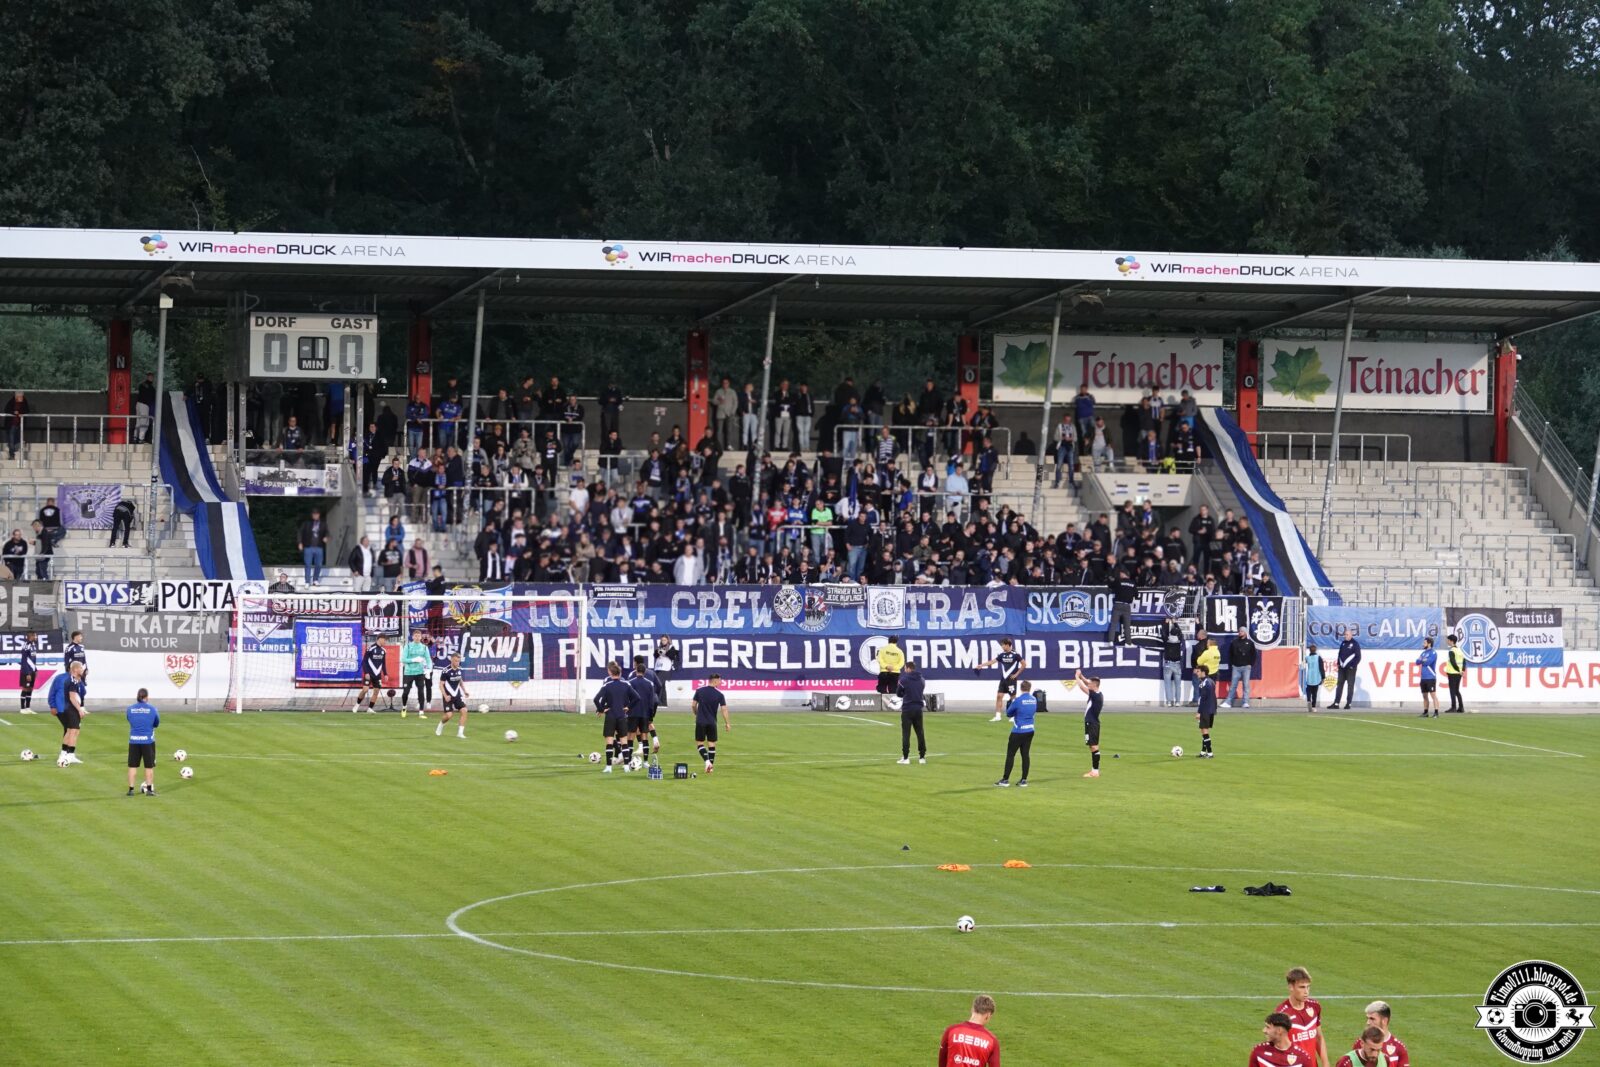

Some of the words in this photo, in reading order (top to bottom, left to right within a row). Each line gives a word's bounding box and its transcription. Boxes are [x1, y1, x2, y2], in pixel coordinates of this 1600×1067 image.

[179, 241, 336, 256] WIRmachenDRUCK
[341, 245, 406, 258] ARENA
[638, 251, 790, 265] WIRmachenDRUCK
[794, 254, 857, 267] ARENA
[1150, 262, 1296, 277] WIRmachenDRUCK
[1299, 265, 1359, 278] ARENA
[255, 316, 297, 328] DORF
[331, 317, 373, 330] GAST
[302, 359, 325, 370] MIN
[1073, 350, 1221, 391] Teinacher
[1349, 355, 1485, 396] Teinacher
[66, 583, 129, 606] BOYS
[162, 583, 235, 610] PORTA
[671, 590, 773, 629] CREW
[1027, 592, 1058, 625] SK
[76, 611, 221, 635] FETTKATZEN
[1505, 611, 1555, 625] Arminia
[306, 627, 353, 645] BLUE
[1309, 620, 1360, 641] copa
[1368, 618, 1439, 638] cALMa
[1457, 628, 1465, 643] B
[1488, 627, 1497, 641] C
[0, 634, 52, 651] ESF.
[120, 636, 139, 649] ON
[142, 636, 178, 649] TOUR
[1507, 632, 1555, 646] Freunde
[259, 643, 290, 652] MINDEN
[559, 634, 851, 670] ANHÄGERCLUB
[1507, 651, 1542, 666] Löhne
[477, 664, 507, 673] ULTRAS
[962, 1056, 980, 1066] JAKO
